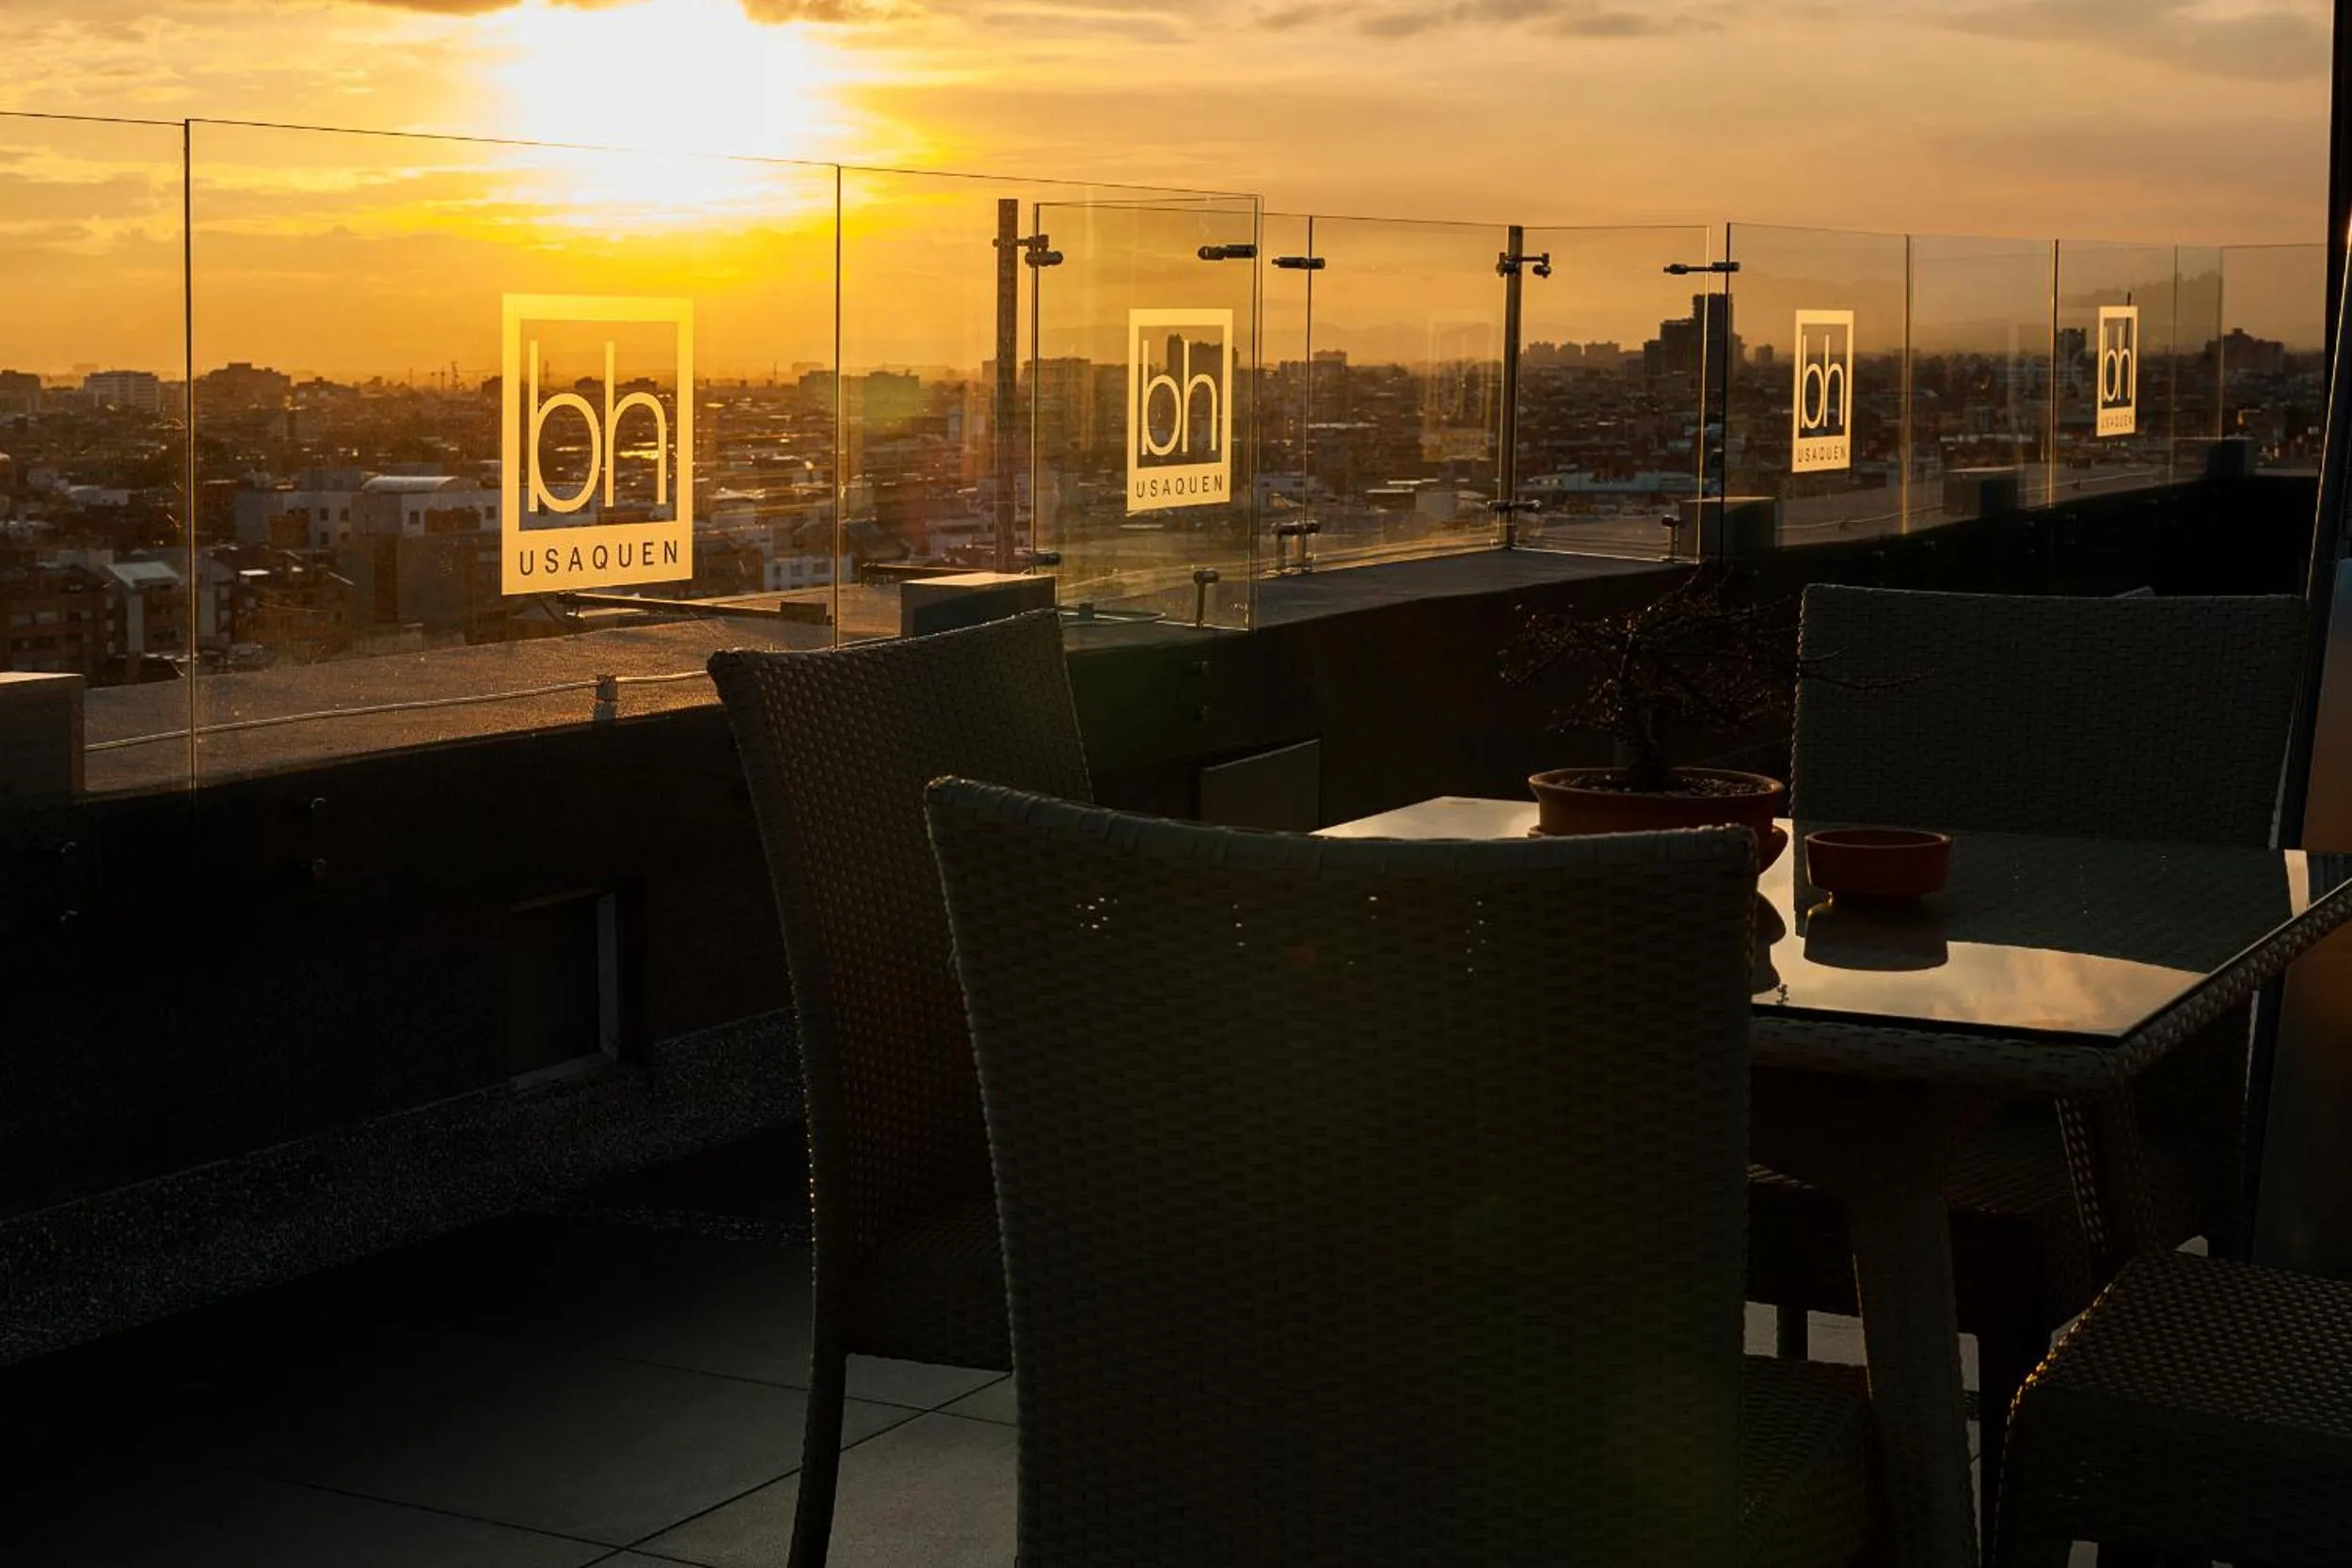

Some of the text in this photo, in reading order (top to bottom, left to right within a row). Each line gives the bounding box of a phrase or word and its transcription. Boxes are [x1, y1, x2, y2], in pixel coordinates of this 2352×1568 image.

[528, 340, 668, 514] bh
[1141, 340, 1217, 456] bh
[1801, 335, 1845, 429] bh
[1136, 474, 1223, 499] USAQUEN
[519, 540, 677, 576] USAQUEN
